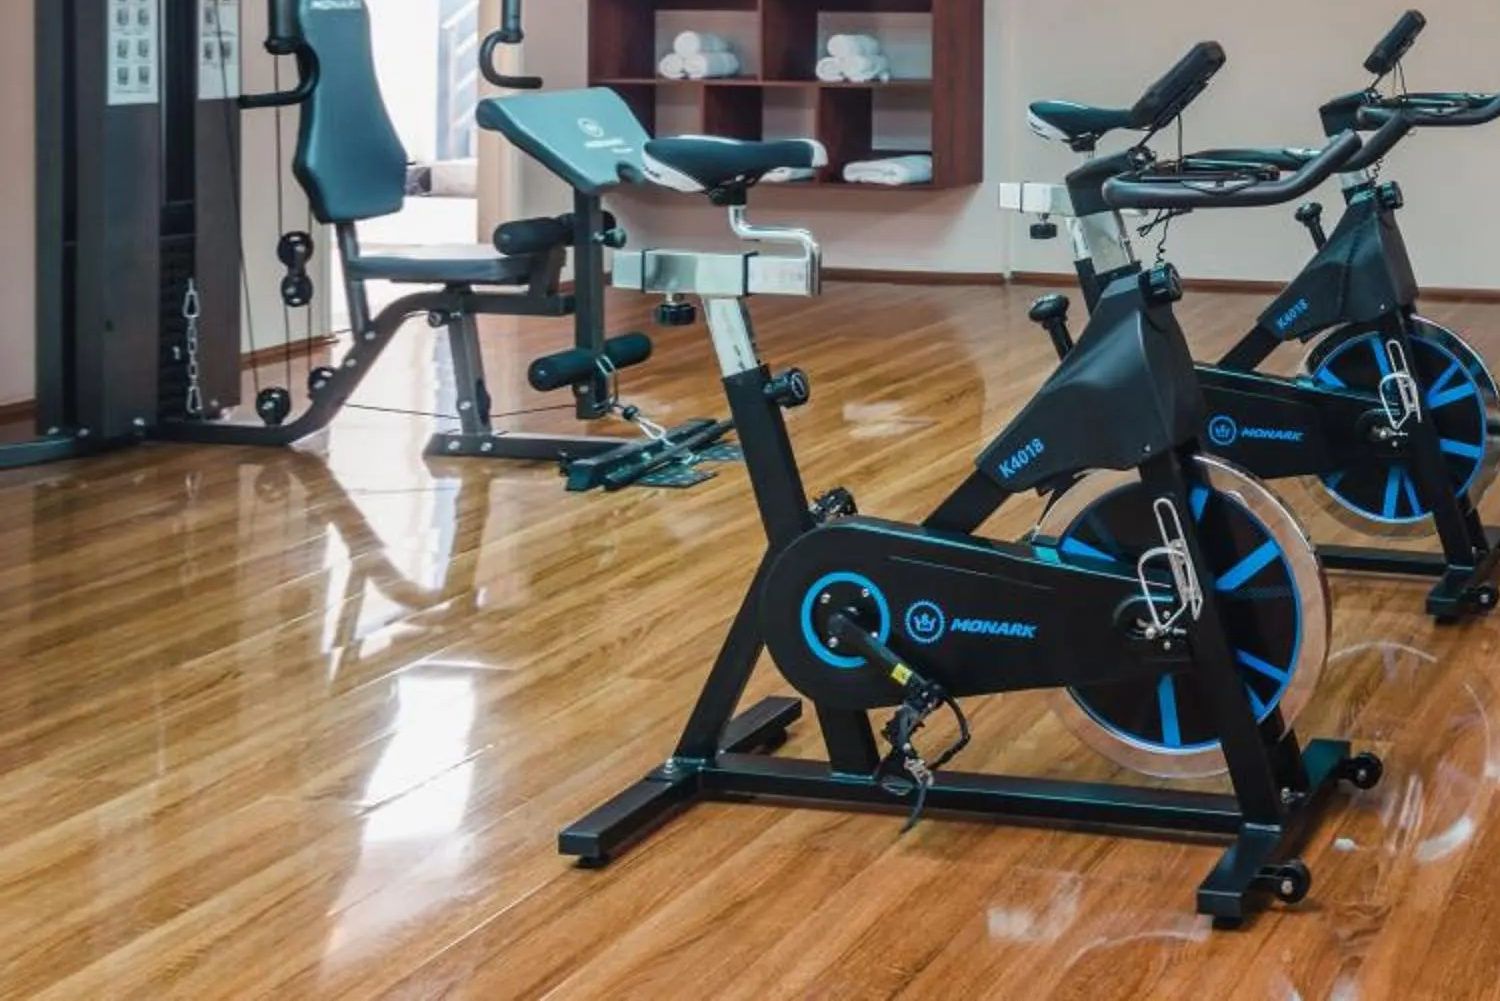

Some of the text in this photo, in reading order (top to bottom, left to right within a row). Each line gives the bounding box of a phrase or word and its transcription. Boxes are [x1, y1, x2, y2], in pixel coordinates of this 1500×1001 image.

[1241, 427, 1304, 441] MONARK
[999, 438, 1044, 478] K4018
[950, 618, 1037, 638] MONARK
